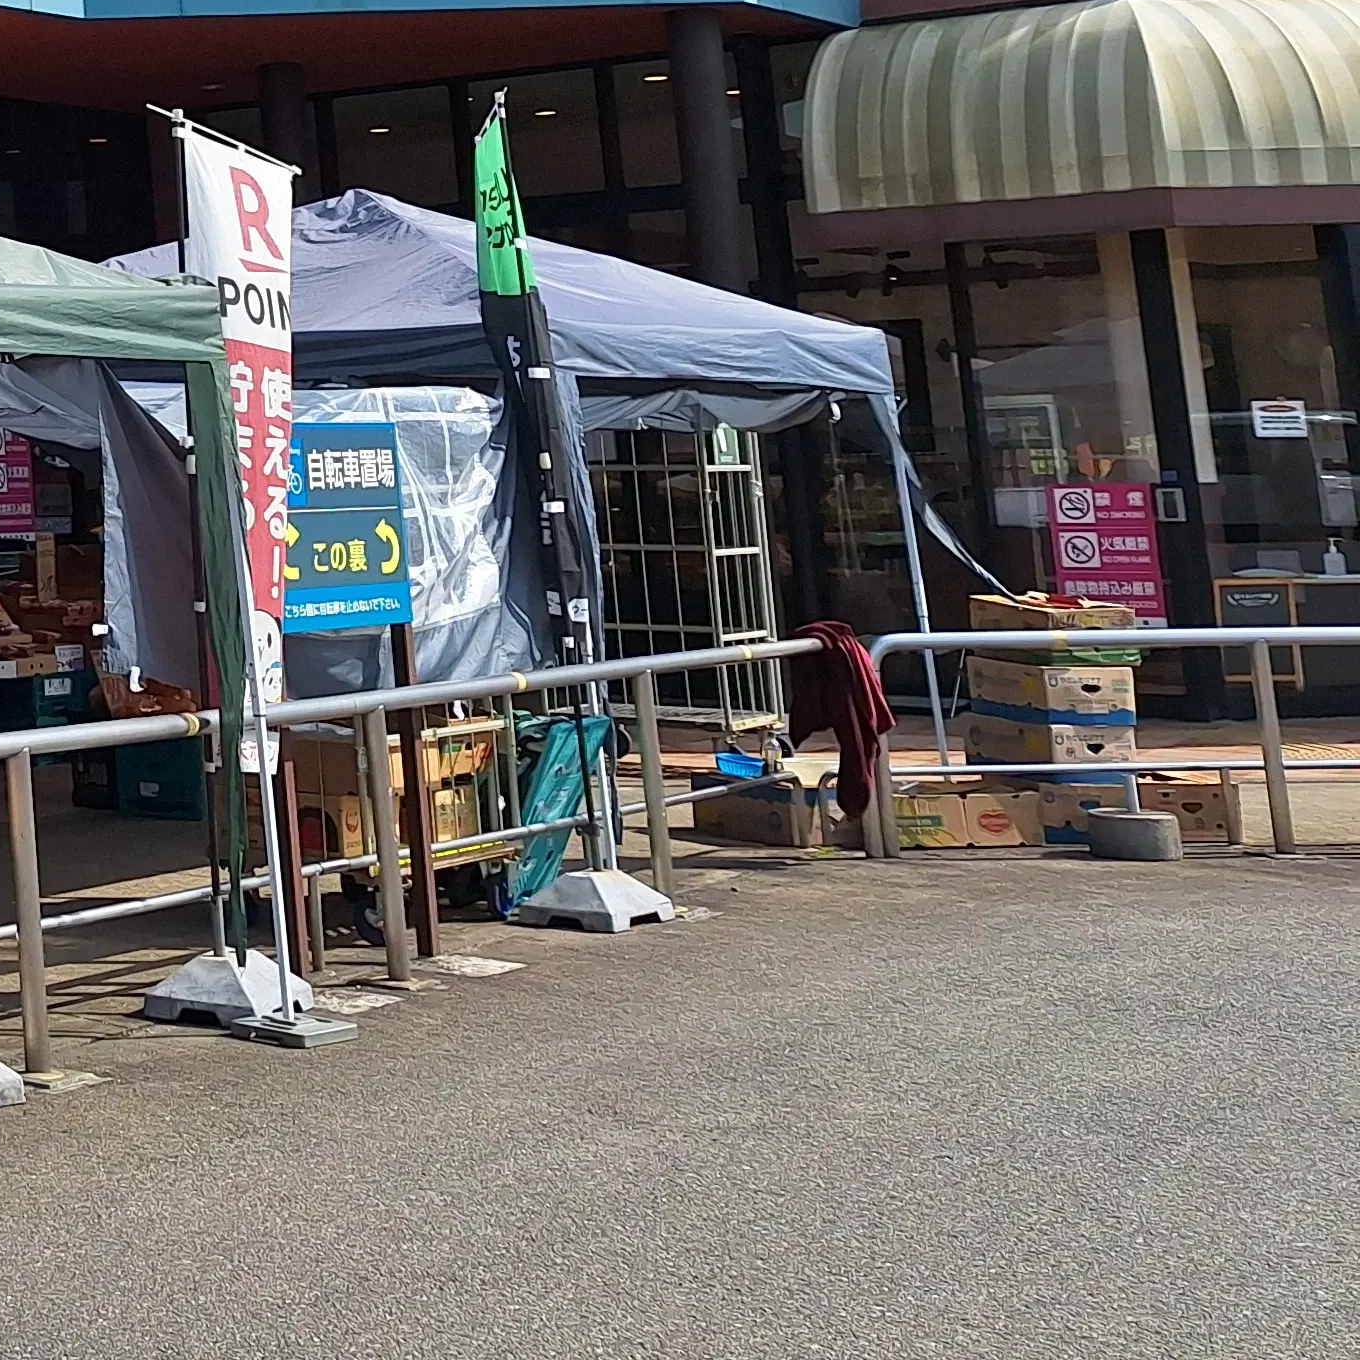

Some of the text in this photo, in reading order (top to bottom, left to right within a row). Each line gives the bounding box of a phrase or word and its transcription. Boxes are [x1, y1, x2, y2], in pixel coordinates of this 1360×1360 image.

[306, 448, 396, 490] 自転車置場
[312, 538, 368, 572] この裏
